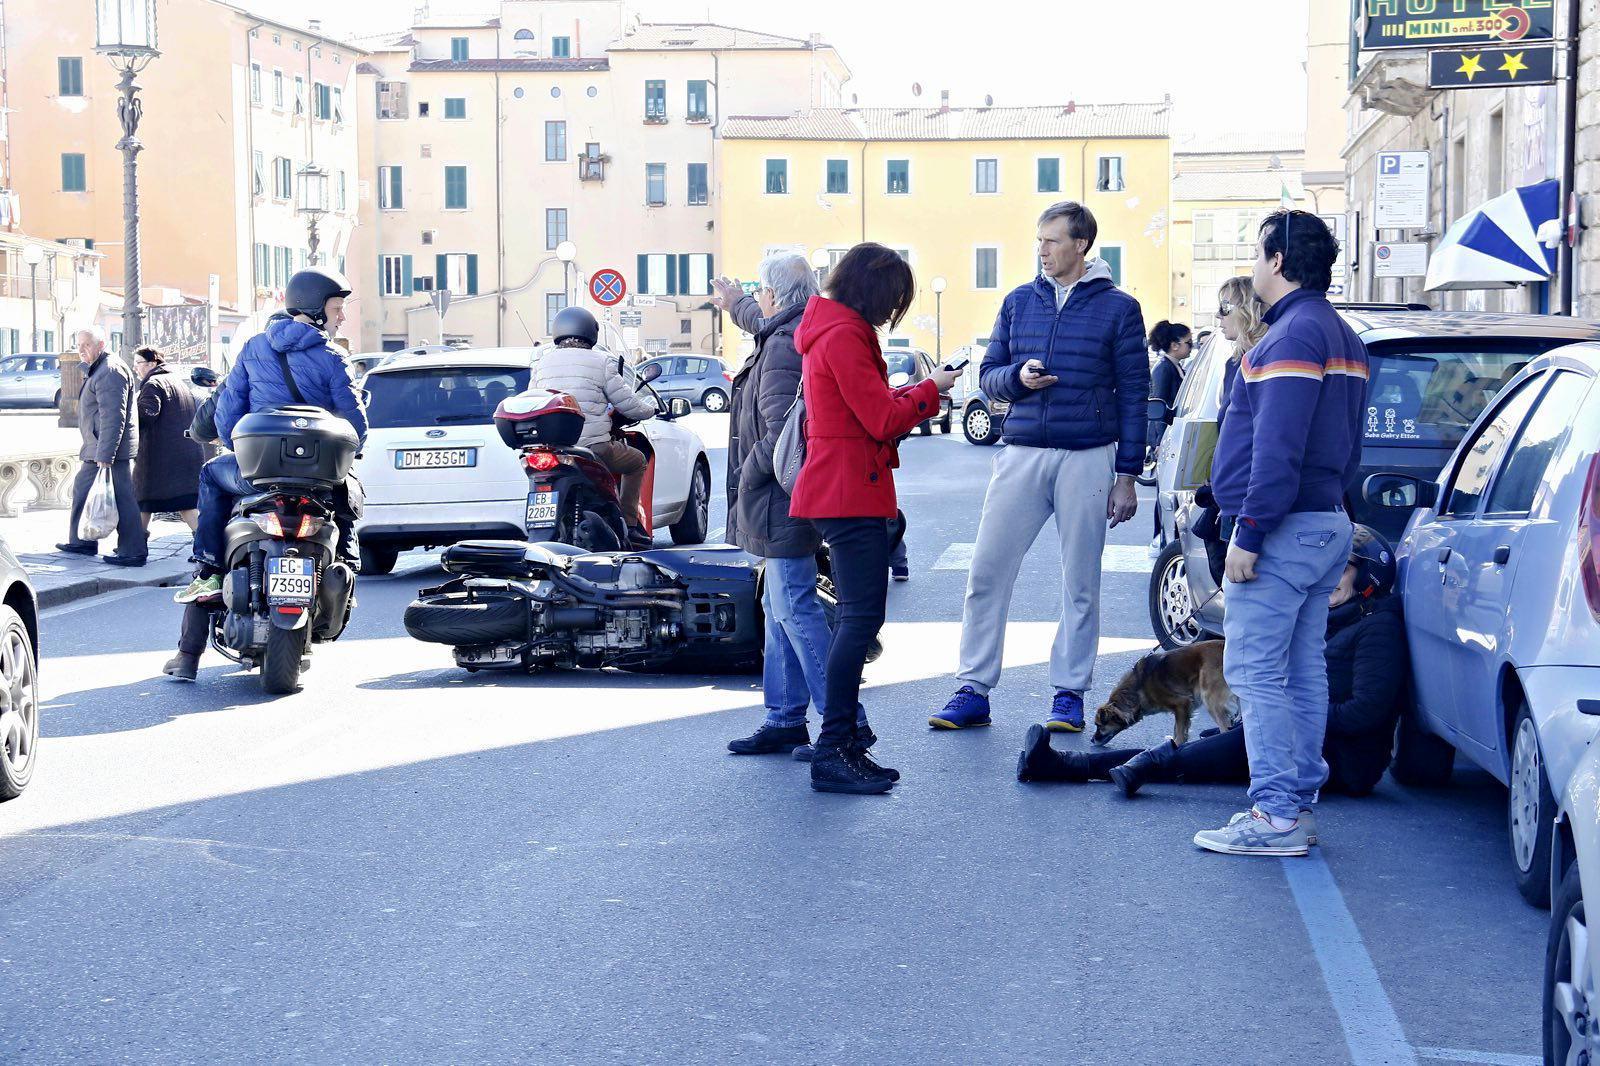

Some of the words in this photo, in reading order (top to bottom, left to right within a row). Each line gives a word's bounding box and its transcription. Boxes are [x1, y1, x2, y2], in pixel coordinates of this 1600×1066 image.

[1408, 22, 1450, 35] MINI
[1476, 19, 1502, 31] 300
[1383, 157, 1396, 173] P
[405, 452, 421, 466] DM
[426, 451, 466, 466] 235GM
[535, 493, 547, 505] EB
[528, 506, 555, 519] 22876
[280, 559, 296, 573] EG
[271, 577, 310, 593] 73599
